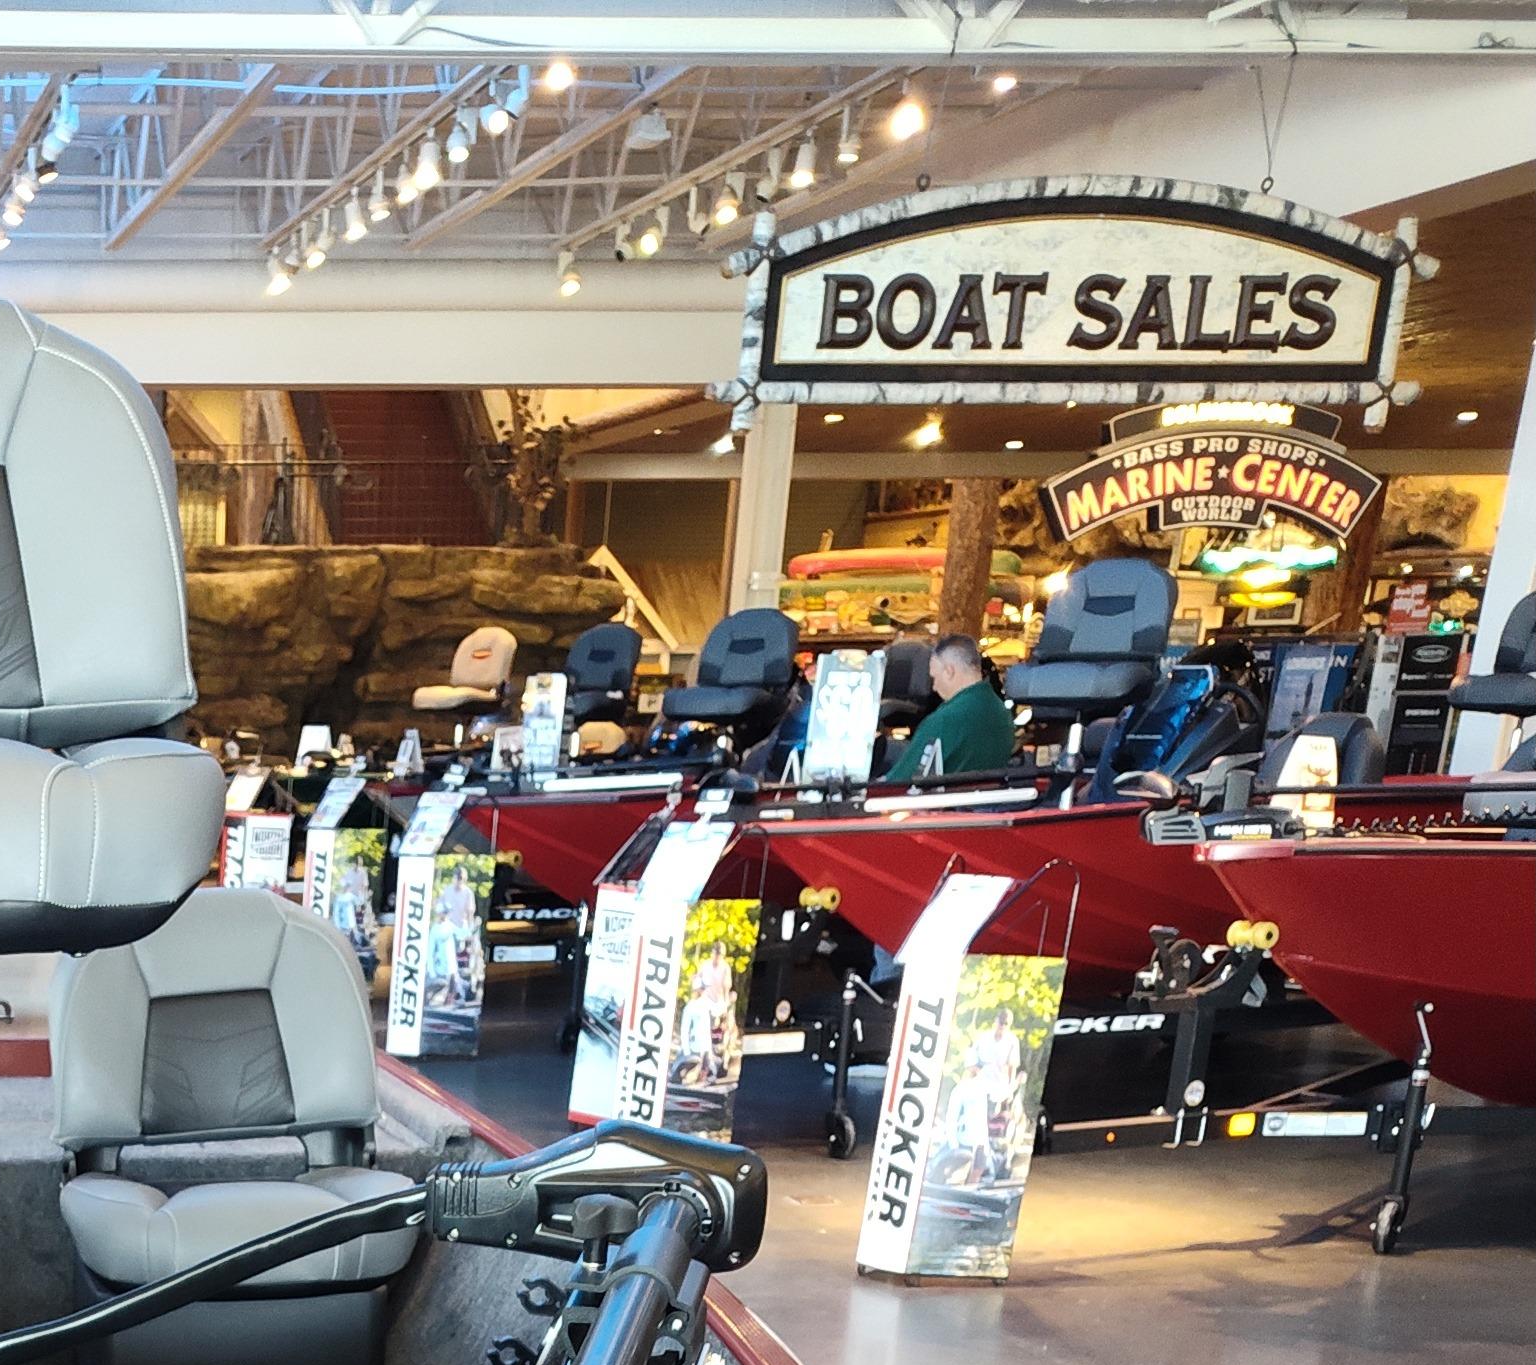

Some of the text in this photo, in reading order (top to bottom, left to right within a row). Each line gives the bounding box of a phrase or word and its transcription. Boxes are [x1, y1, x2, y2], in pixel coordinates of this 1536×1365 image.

[816, 271, 1341, 353] BOAT SALES
[1066, 453, 1361, 530] MARINE CENTER
[1123, 438, 1319, 468] BASS PRO SHOPS
[1172, 496, 1255, 512] OUTDOOR
[1182, 508, 1242, 522] WORLD
[500, 908, 578, 920] TRAC
[400, 883, 425, 1029] TRACKER
[630, 936, 674, 1122] TRACKER
[878, 998, 944, 1229] TRACKER
